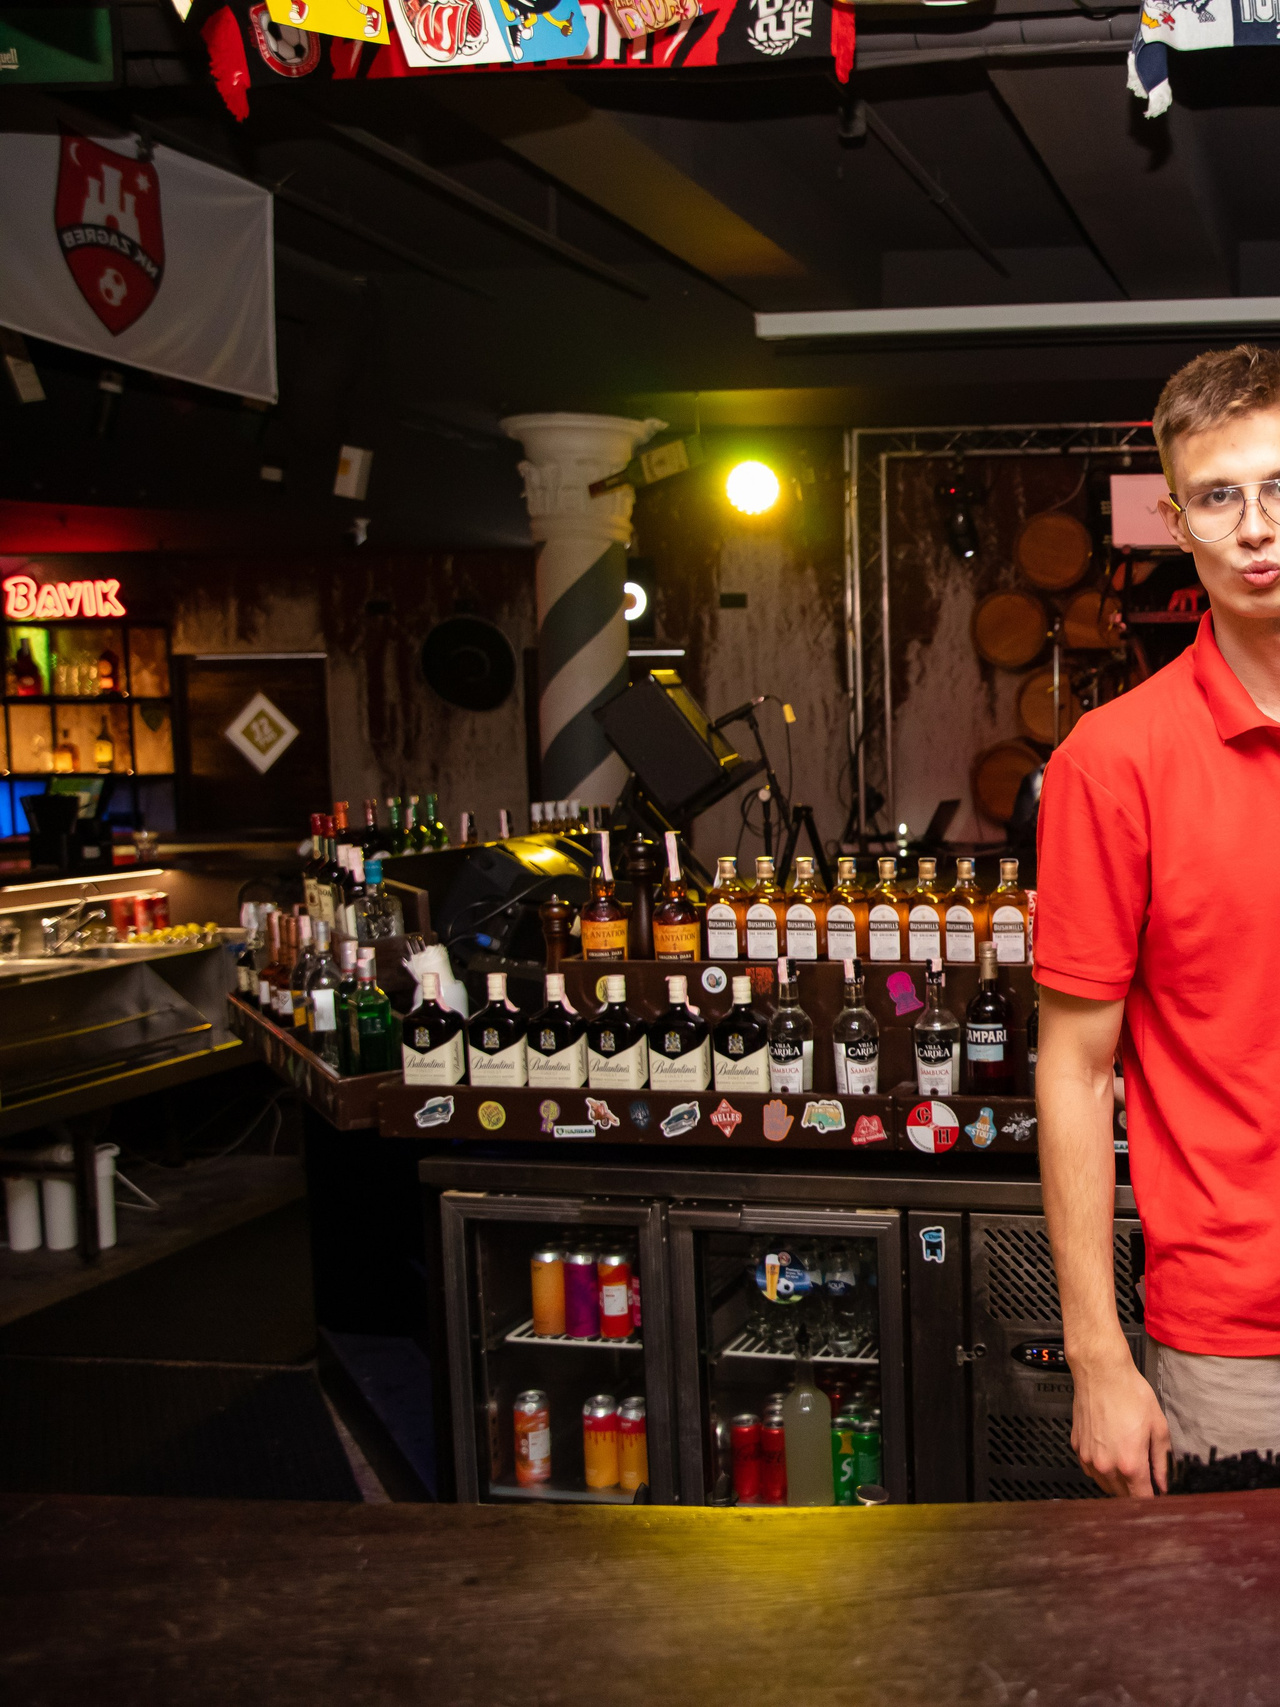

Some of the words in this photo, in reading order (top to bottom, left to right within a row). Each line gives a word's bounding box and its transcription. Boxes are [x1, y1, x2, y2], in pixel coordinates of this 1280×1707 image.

[3, 575, 127, 618] BAVIK
[967, 1029, 1007, 1043] AMPARI
[918, 1047, 950, 1060] CARDEA
[771, 1066, 800, 1074] SAMBUCA
[712, 1112, 741, 1123] HELLES
[976, 1122, 990, 1132] OUT
[971, 1128, 994, 1140] STOUT
